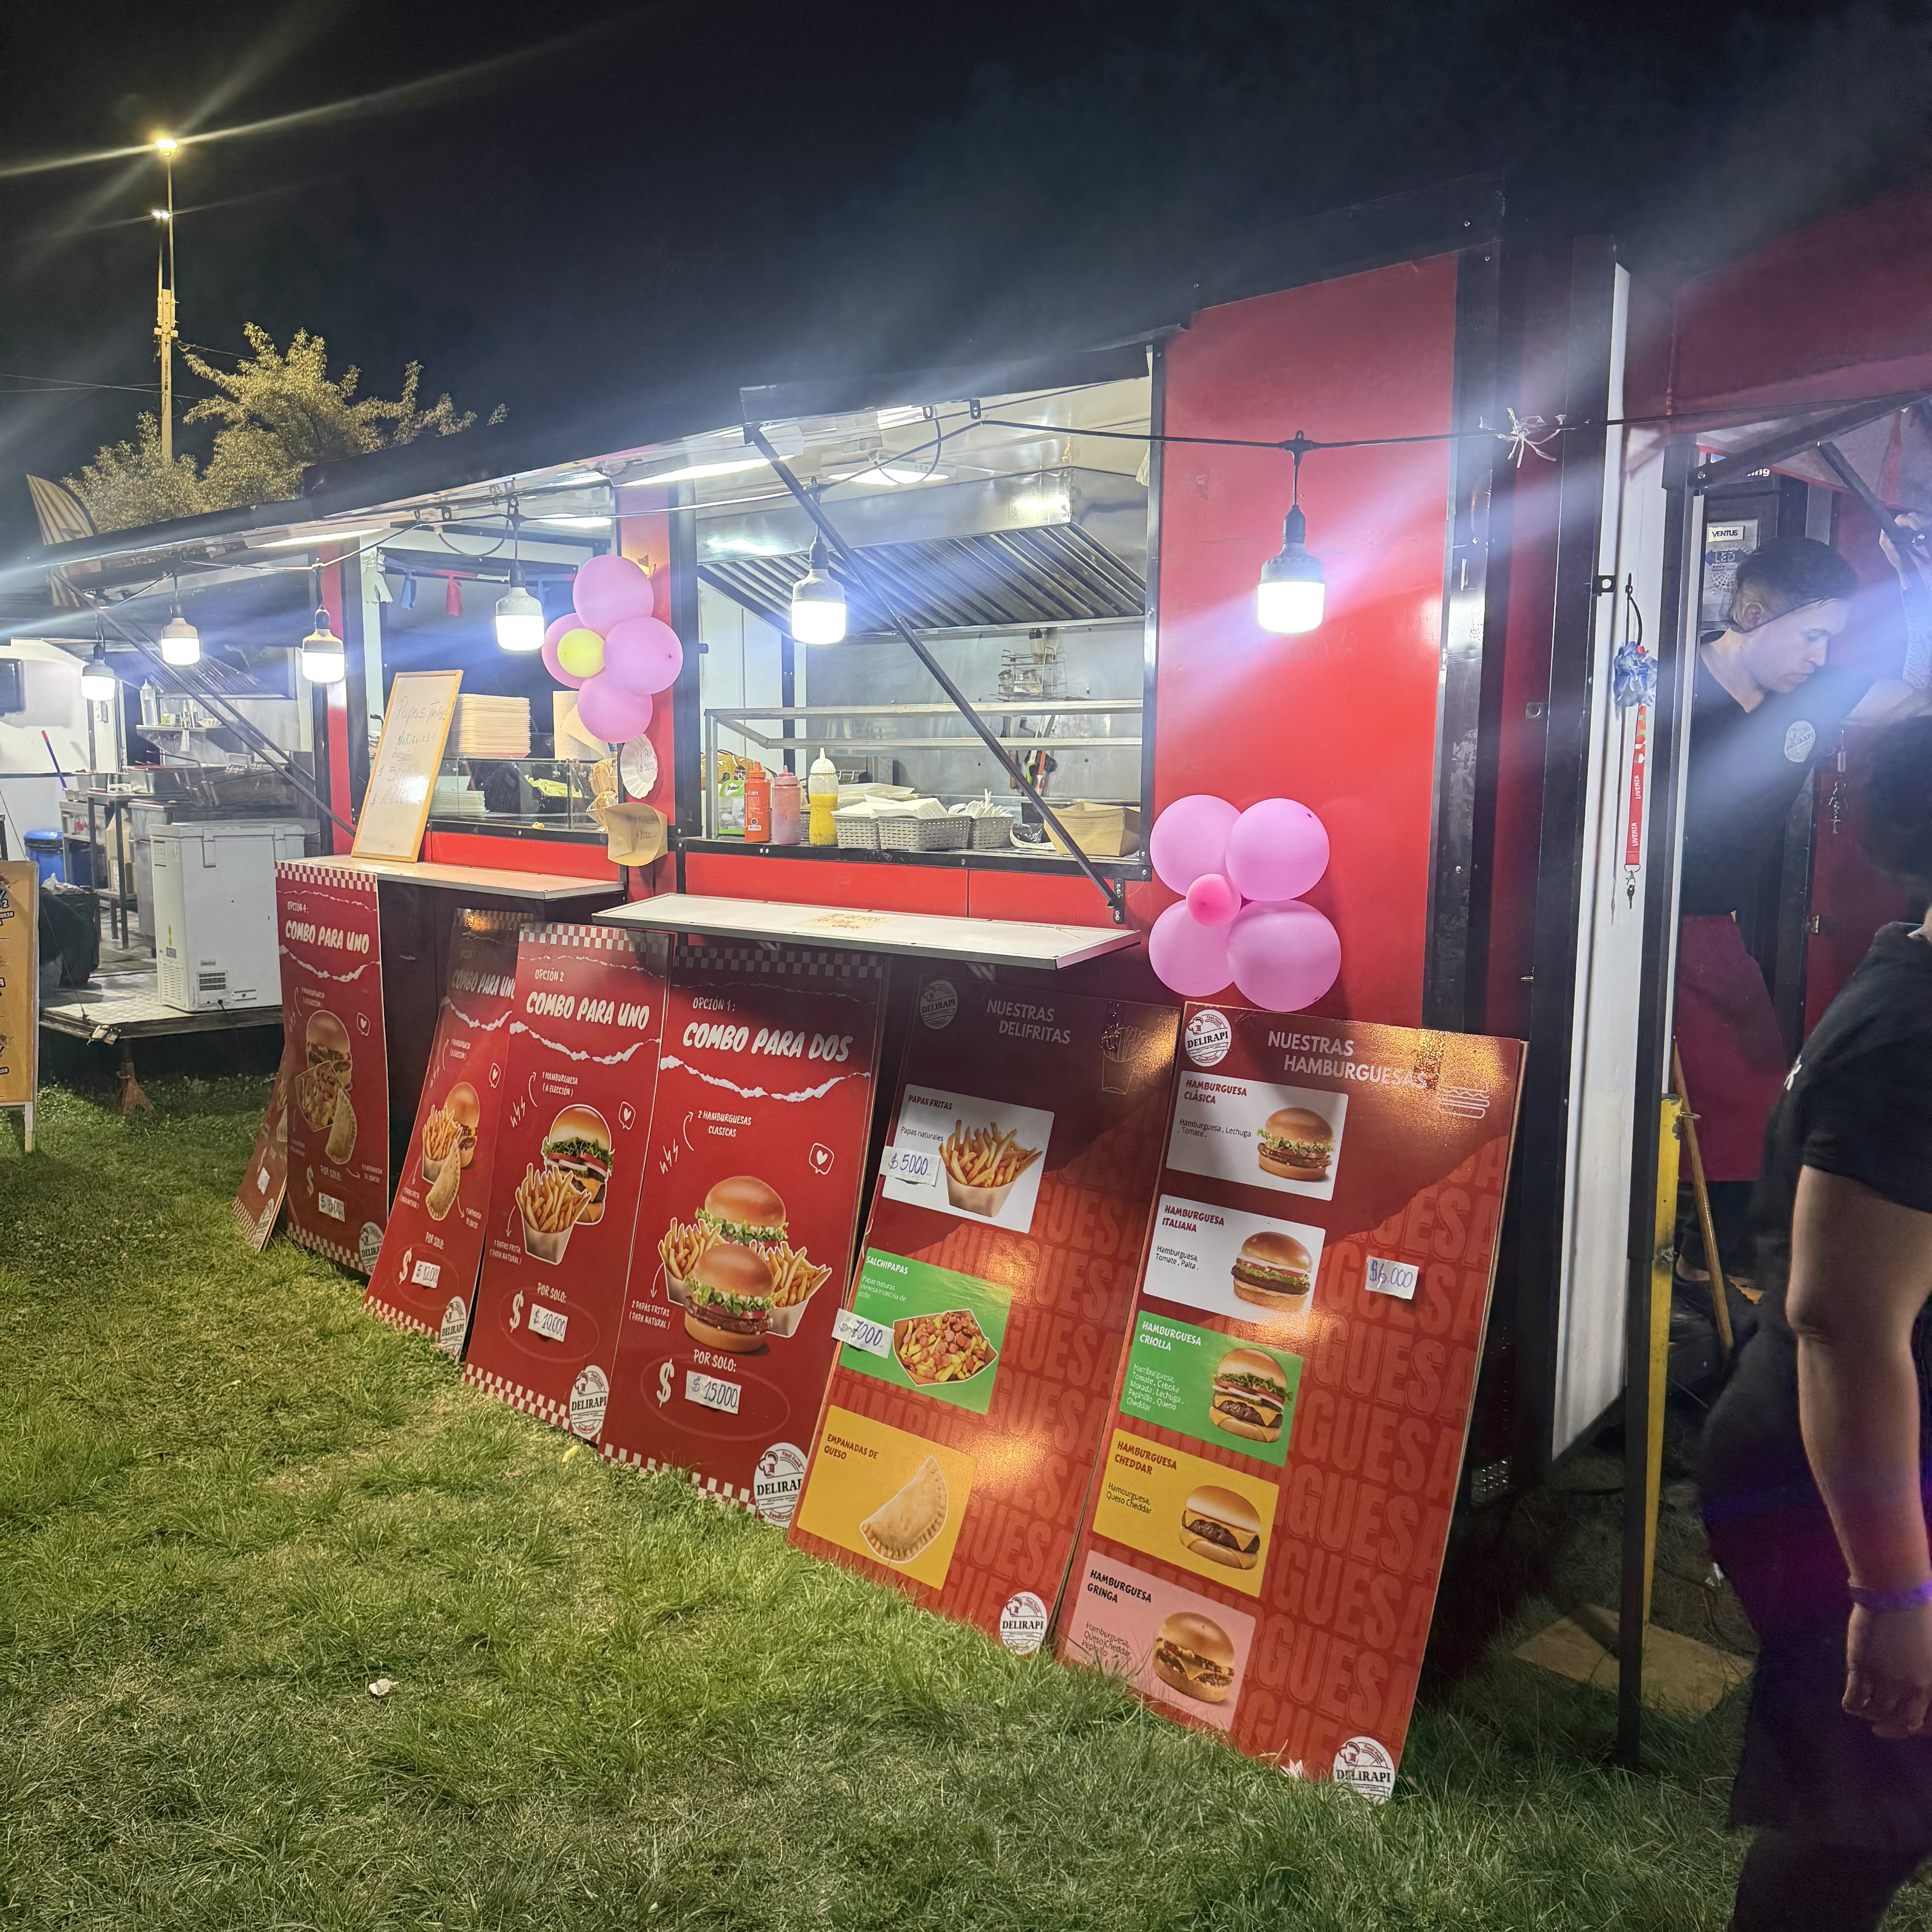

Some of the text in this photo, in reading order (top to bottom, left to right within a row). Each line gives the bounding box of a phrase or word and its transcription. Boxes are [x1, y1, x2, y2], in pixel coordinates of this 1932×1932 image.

[1712, 529, 1738, 538] VENTUS
[285, 920, 369, 954] COMBO PARA UNO
[452, 969, 478, 992] COMBO
[477, 973, 500, 995] PARA
[535, 968, 564, 982] OPCIÓN 2
[526, 991, 649, 1030] COMBO PARA UNO
[693, 996, 724, 1011] OPCIÓN
[922, 999, 955, 1013] DELIRAPI
[987, 999, 1054, 1022] NUESTRAS
[998, 1020, 1071, 1044] DELIFRITAS
[1187, 1031, 1228, 1049] DELIRAPI
[683, 1022, 853, 1062] COMBO PARA DOS
[1268, 1031, 1354, 1057] NUESTRAS
[545, 1073, 578, 1085] HAMBURGUESA
[1283, 1054, 1428, 1090] HAMBURGUESAS
[1186, 1079, 1247, 1096] HAMBURGUESA
[908, 1095, 953, 1110] PAPAS FRITAS
[1184, 1090, 1216, 1104] CLÁSICA
[698, 1110, 752, 1126] 2 HAMBURGUESAS
[708, 1126, 736, 1137] CLASICAS
[901, 1127, 944, 1142] Papas naturales
[1226, 1127, 1251, 1138] Lechuga
[888, 1153, 898, 1170] $
[307, 1164, 313, 1197] $
[1164, 1205, 1224, 1226] HAMBURGUESA
[1162, 1218, 1197, 1233] ITALIANA
[426, 1232, 434, 1244] POR
[1157, 1246, 1198, 1262] Hamburguesa,
[399, 1247, 412, 1285] $
[866, 1256, 909, 1275] SALCHIPAPAS
[862, 1275, 876, 1285] Papas
[537, 1282, 566, 1304] POR SOLO:
[510, 1290, 524, 1333] $
[636, 1302, 651, 1313] PAPAS
[652, 1305, 670, 1317] FRITAS
[442, 1323, 464, 1337] DELIRAPI
[1142, 1321, 1201, 1346] HAMBURGUESA
[1140, 1334, 1171, 1351] CRIOLLA
[693, 1349, 736, 1372] POR SOLO:
[656, 1358, 674, 1408] $
[692, 1375, 701, 1392] $
[571, 1396, 607, 1411] DELIRAPI
[1127, 1397, 1151, 1411] Cheddar
[1157, 1398, 1176, 1410] Queso
[824, 1446, 846, 1460] QUESO
[827, 1434, 878, 1459] EMPANADAS DE
[1118, 1440, 1177, 1470] HAMBURGUESA
[1115, 1454, 1153, 1475] CHEDDAR
[1108, 1482, 1150, 1506] Hamburguesa,
[1106, 1491, 1152, 1515] Queso Cheddar
[1087, 1583, 1118, 1603] GRINGA
[1090, 1569, 1151, 1603] HAMBURGUESA
[1003, 1620, 1044, 1629] DELIRAPI
[1084, 1631, 1104, 1645] Queso
[1336, 1770, 1391, 1783] DELIRAPI
